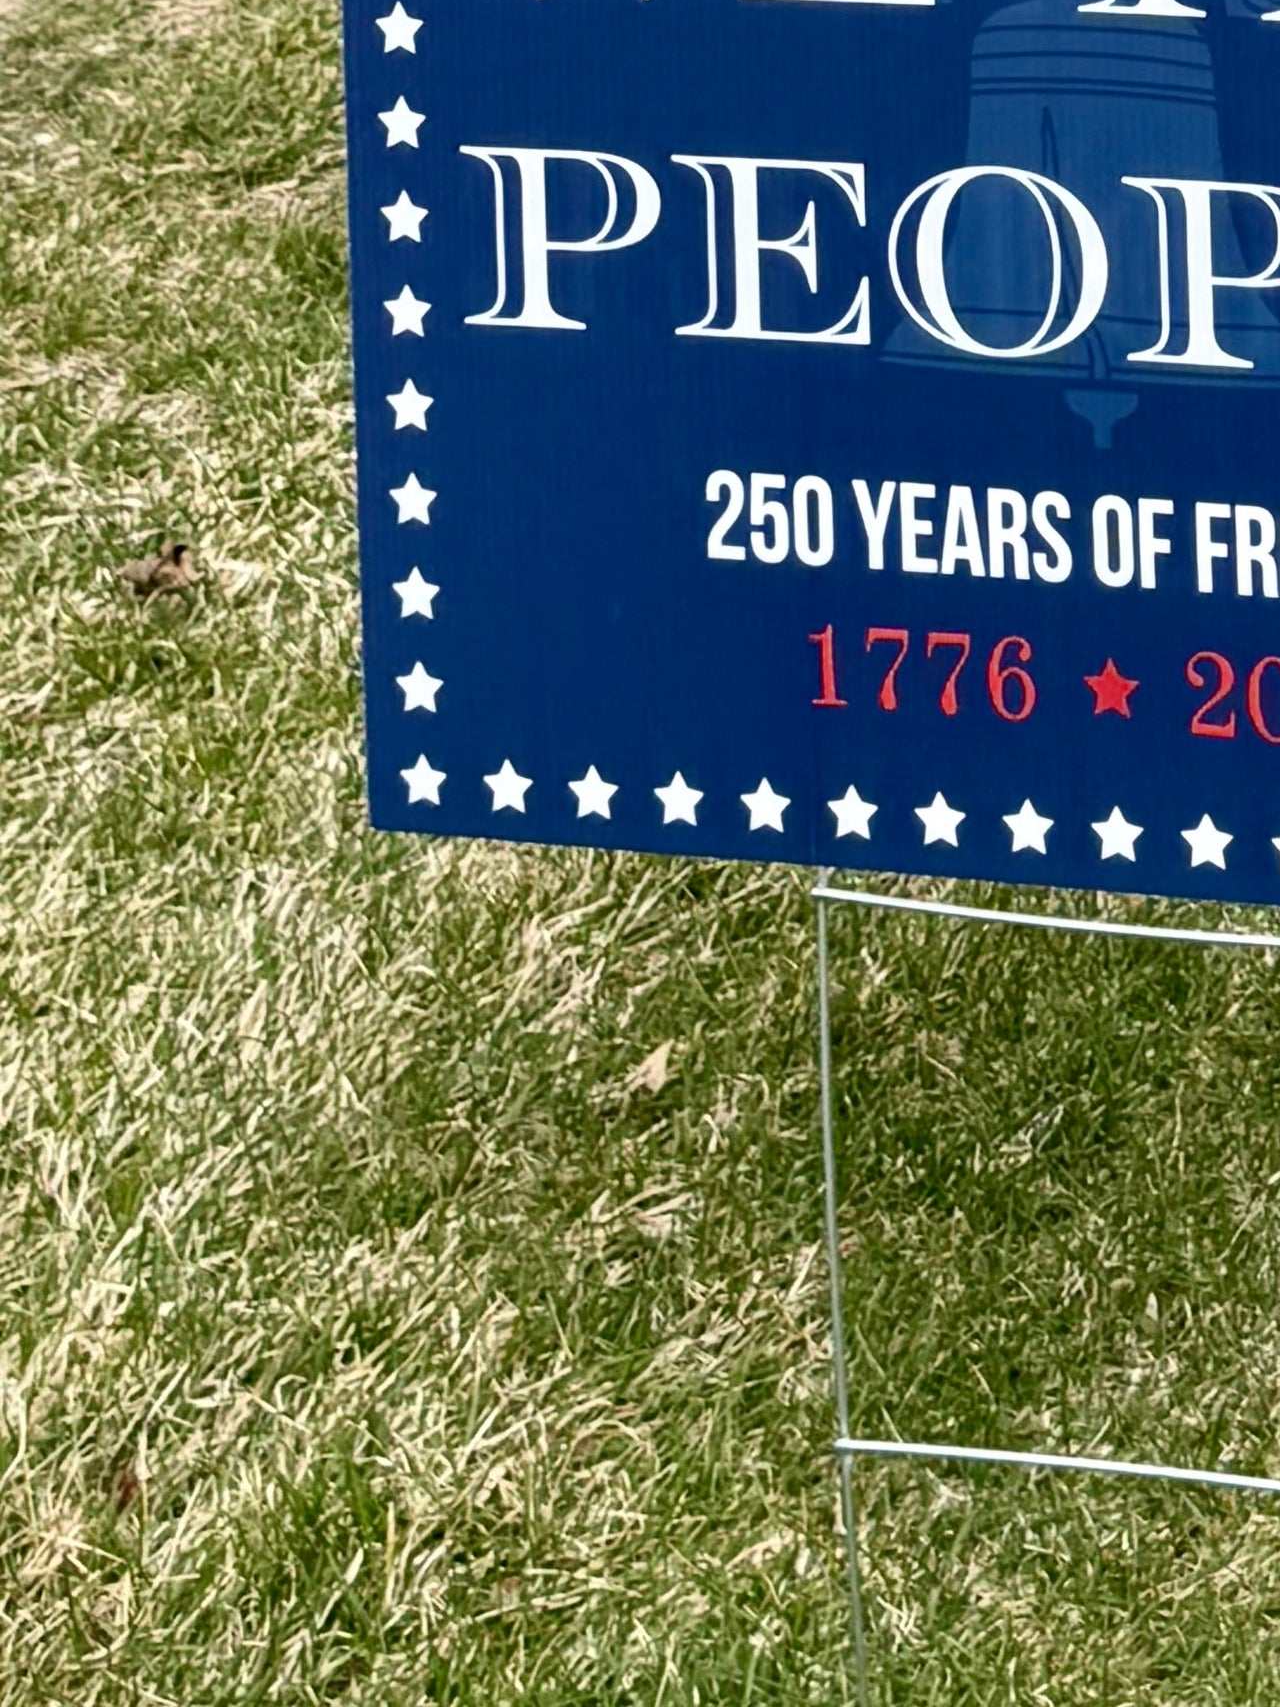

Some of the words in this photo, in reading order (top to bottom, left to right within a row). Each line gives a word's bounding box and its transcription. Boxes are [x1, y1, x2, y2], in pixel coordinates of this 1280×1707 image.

[705, 469, 834, 567] 250
[851, 479, 1073, 583] YEARS
[1091, 494, 1174, 589] OF
[808, 624, 1038, 723] 1776
